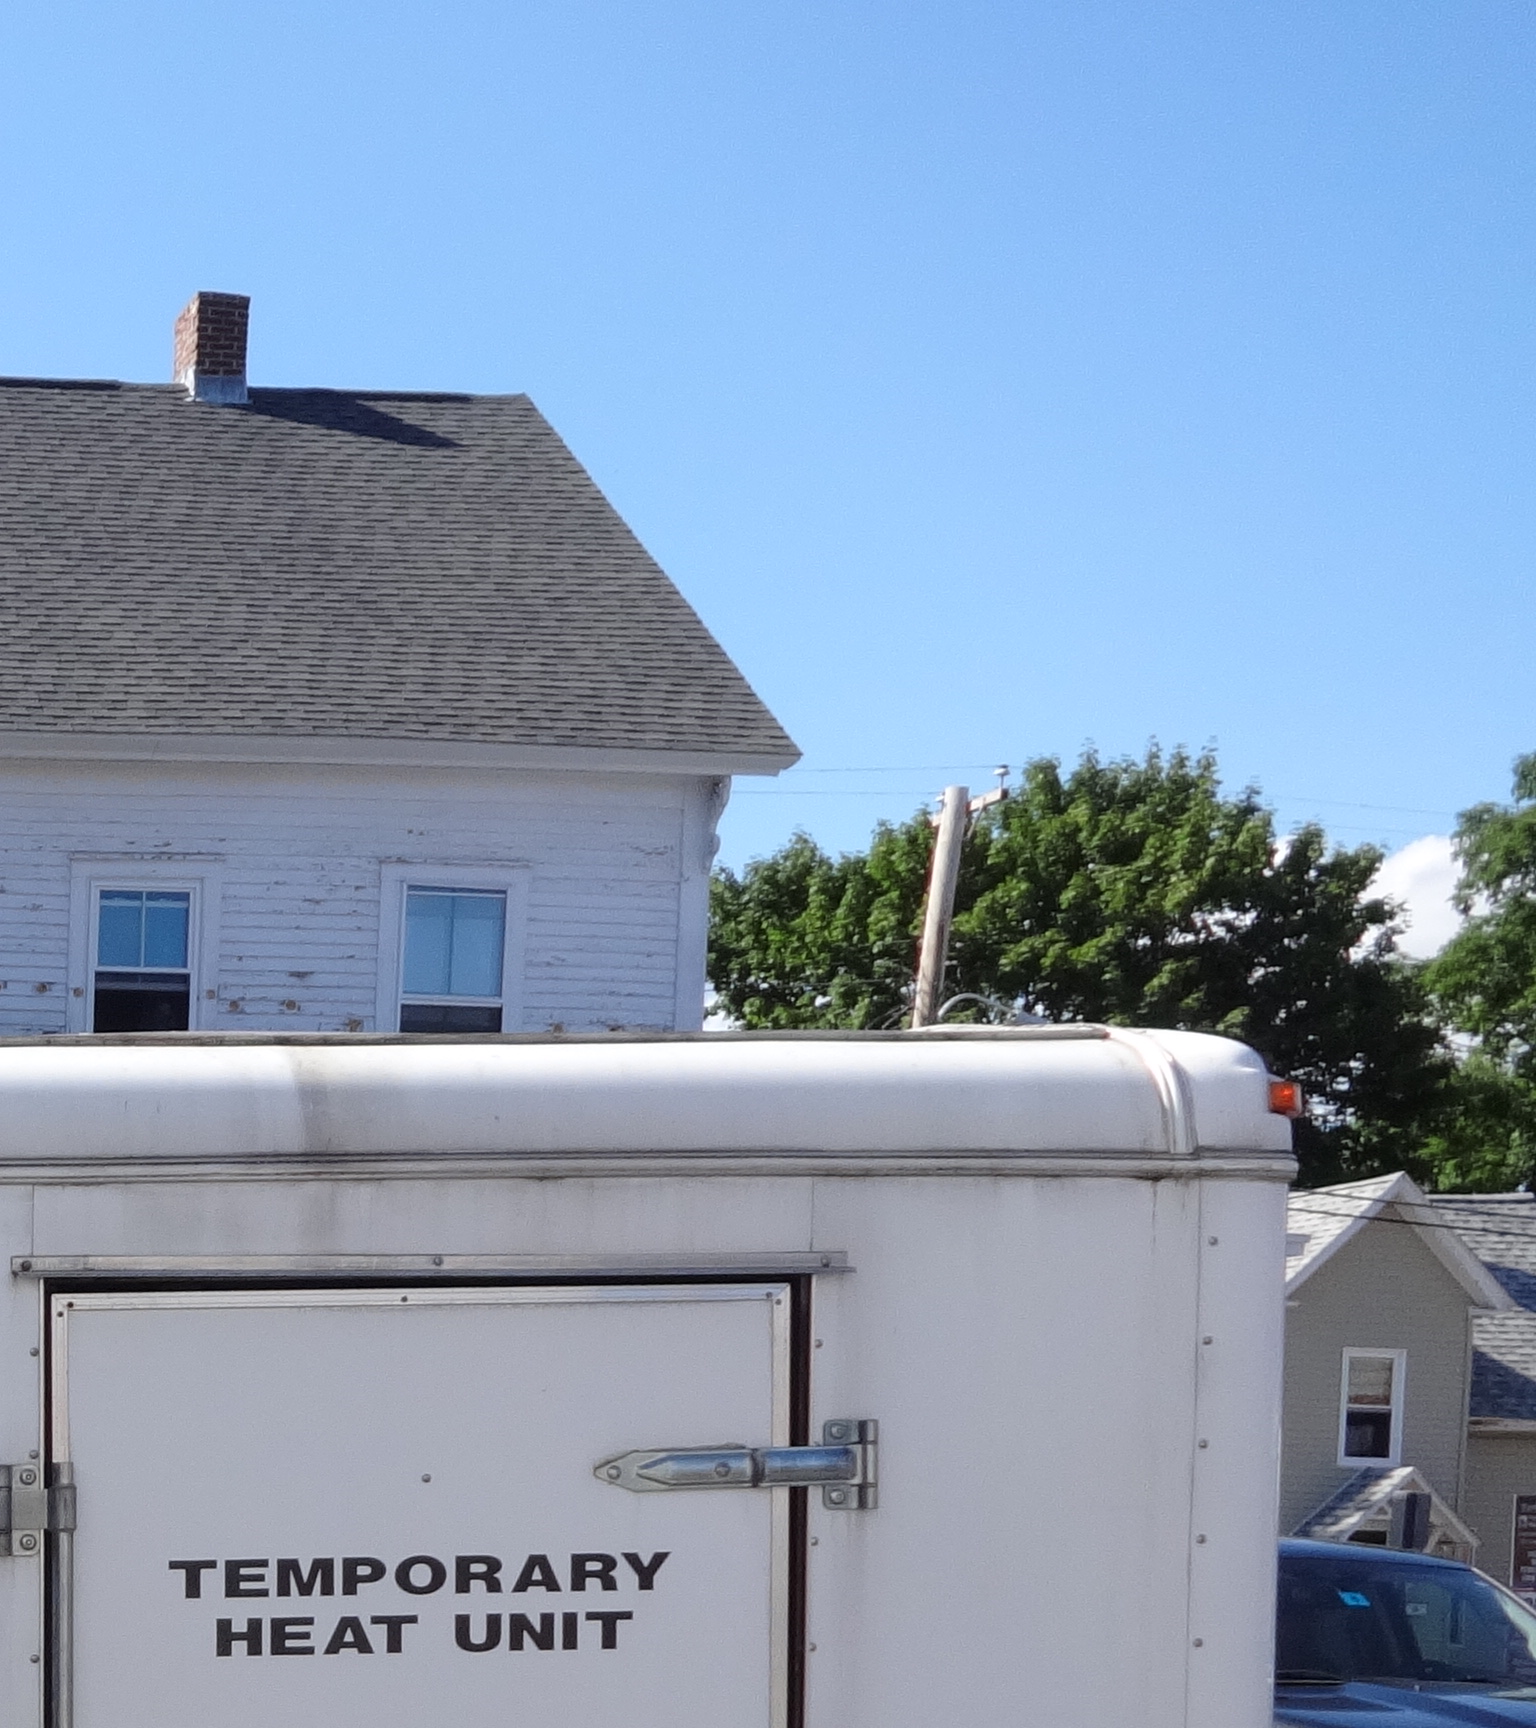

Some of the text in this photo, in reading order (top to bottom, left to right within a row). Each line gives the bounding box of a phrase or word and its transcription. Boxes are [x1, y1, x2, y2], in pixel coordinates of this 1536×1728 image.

[168, 1551, 670, 1599] TEMPORARY
[216, 1610, 633, 1657] HEAT UNIT
